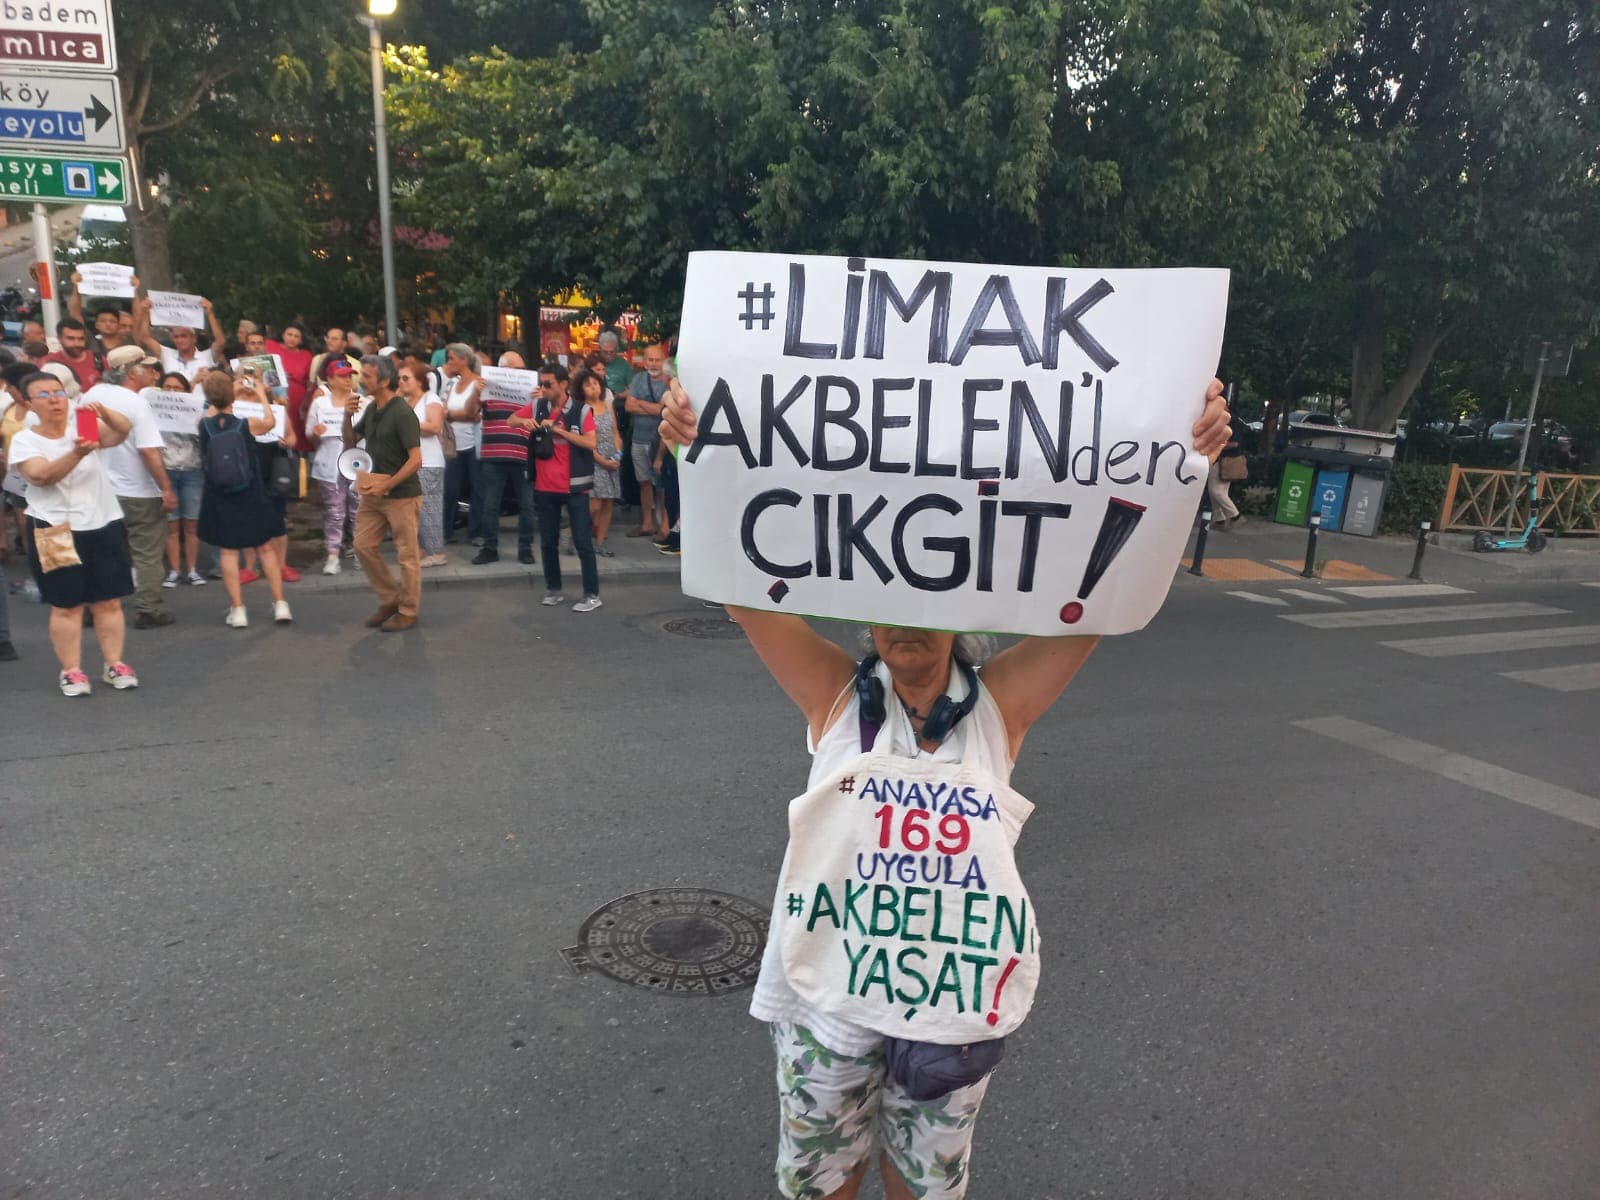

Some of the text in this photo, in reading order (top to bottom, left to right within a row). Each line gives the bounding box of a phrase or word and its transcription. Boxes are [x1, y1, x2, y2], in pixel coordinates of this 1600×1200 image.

[0, 113, 84, 138] eyolu
[874, 804, 971, 856] 169
[857, 852, 987, 891] UYGULA
[843, 939, 1019, 1026] YAŞAT!
